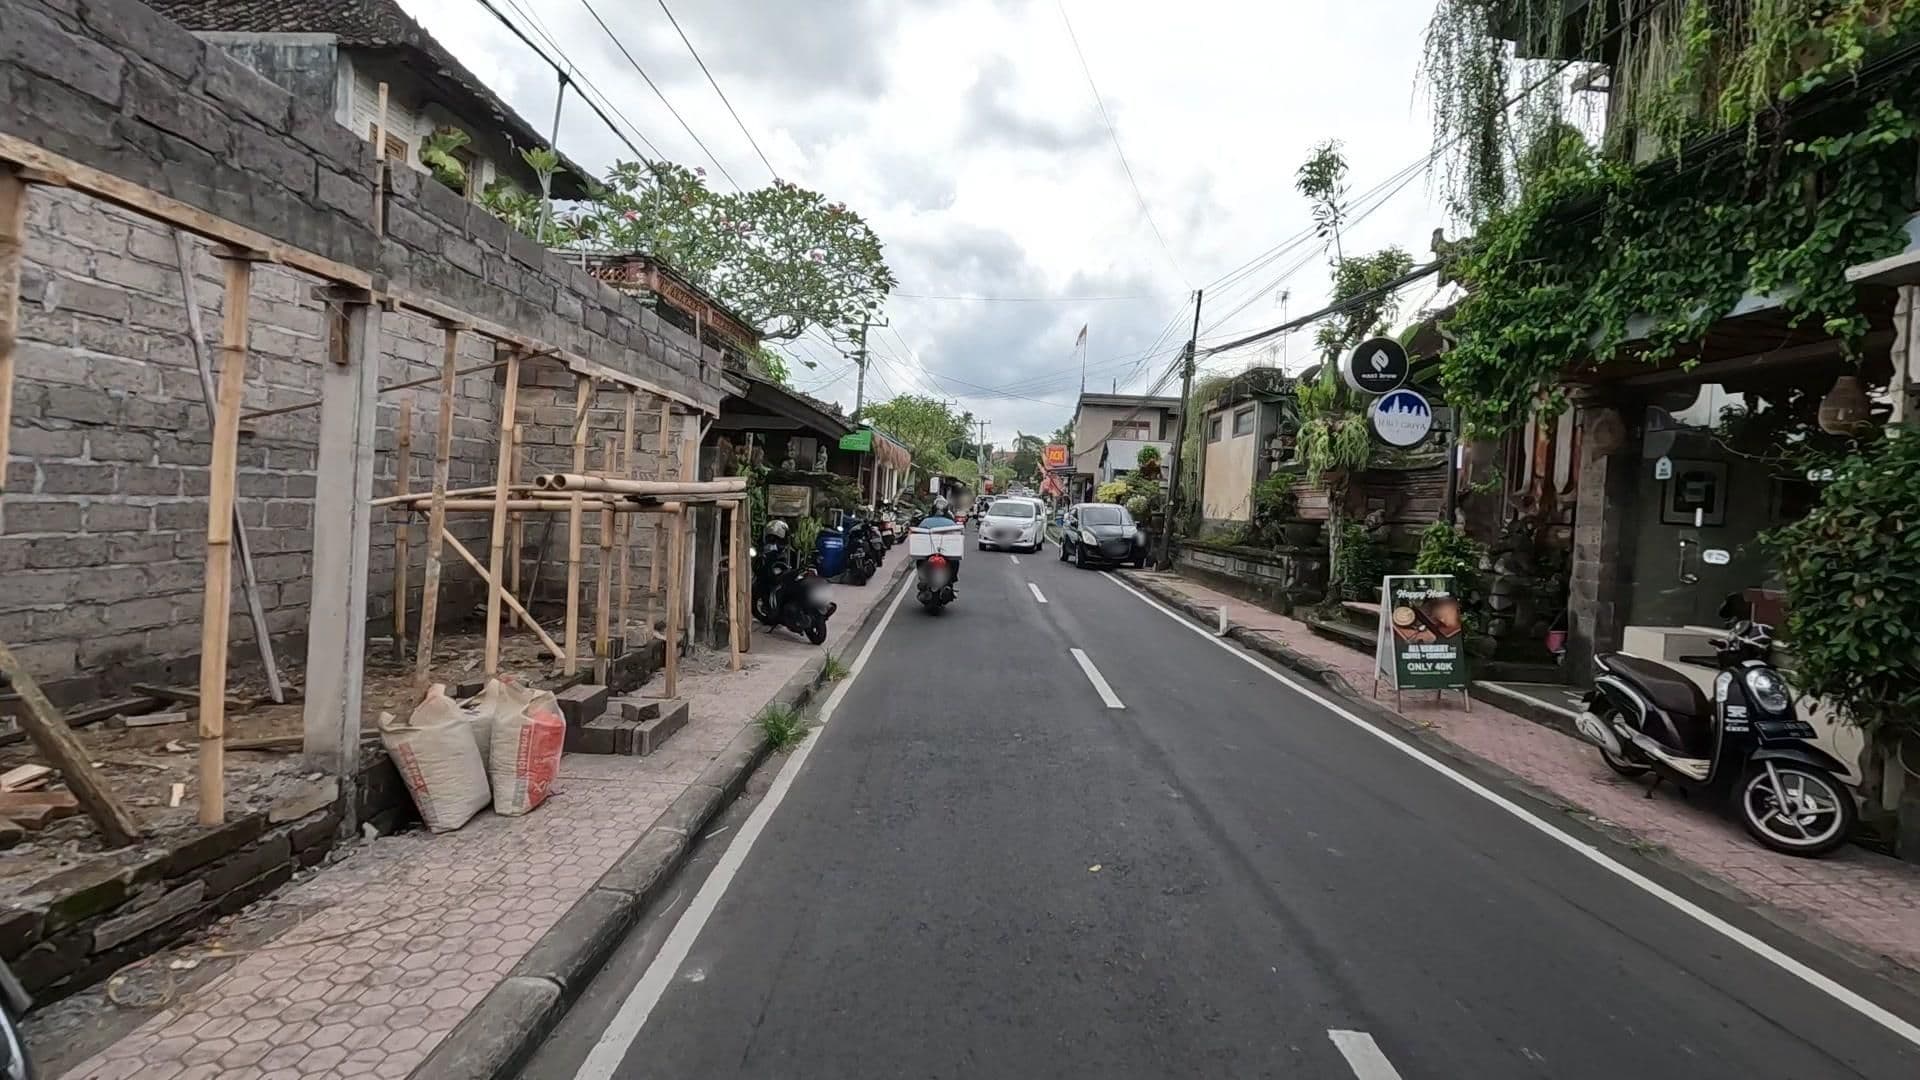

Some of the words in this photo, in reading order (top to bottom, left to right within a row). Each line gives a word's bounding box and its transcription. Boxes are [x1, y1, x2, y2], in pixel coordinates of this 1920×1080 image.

[1396, 589, 1426, 600] Happy
[1407, 662, 1433, 671] ONLY
[1434, 662, 1453, 671] 40K
